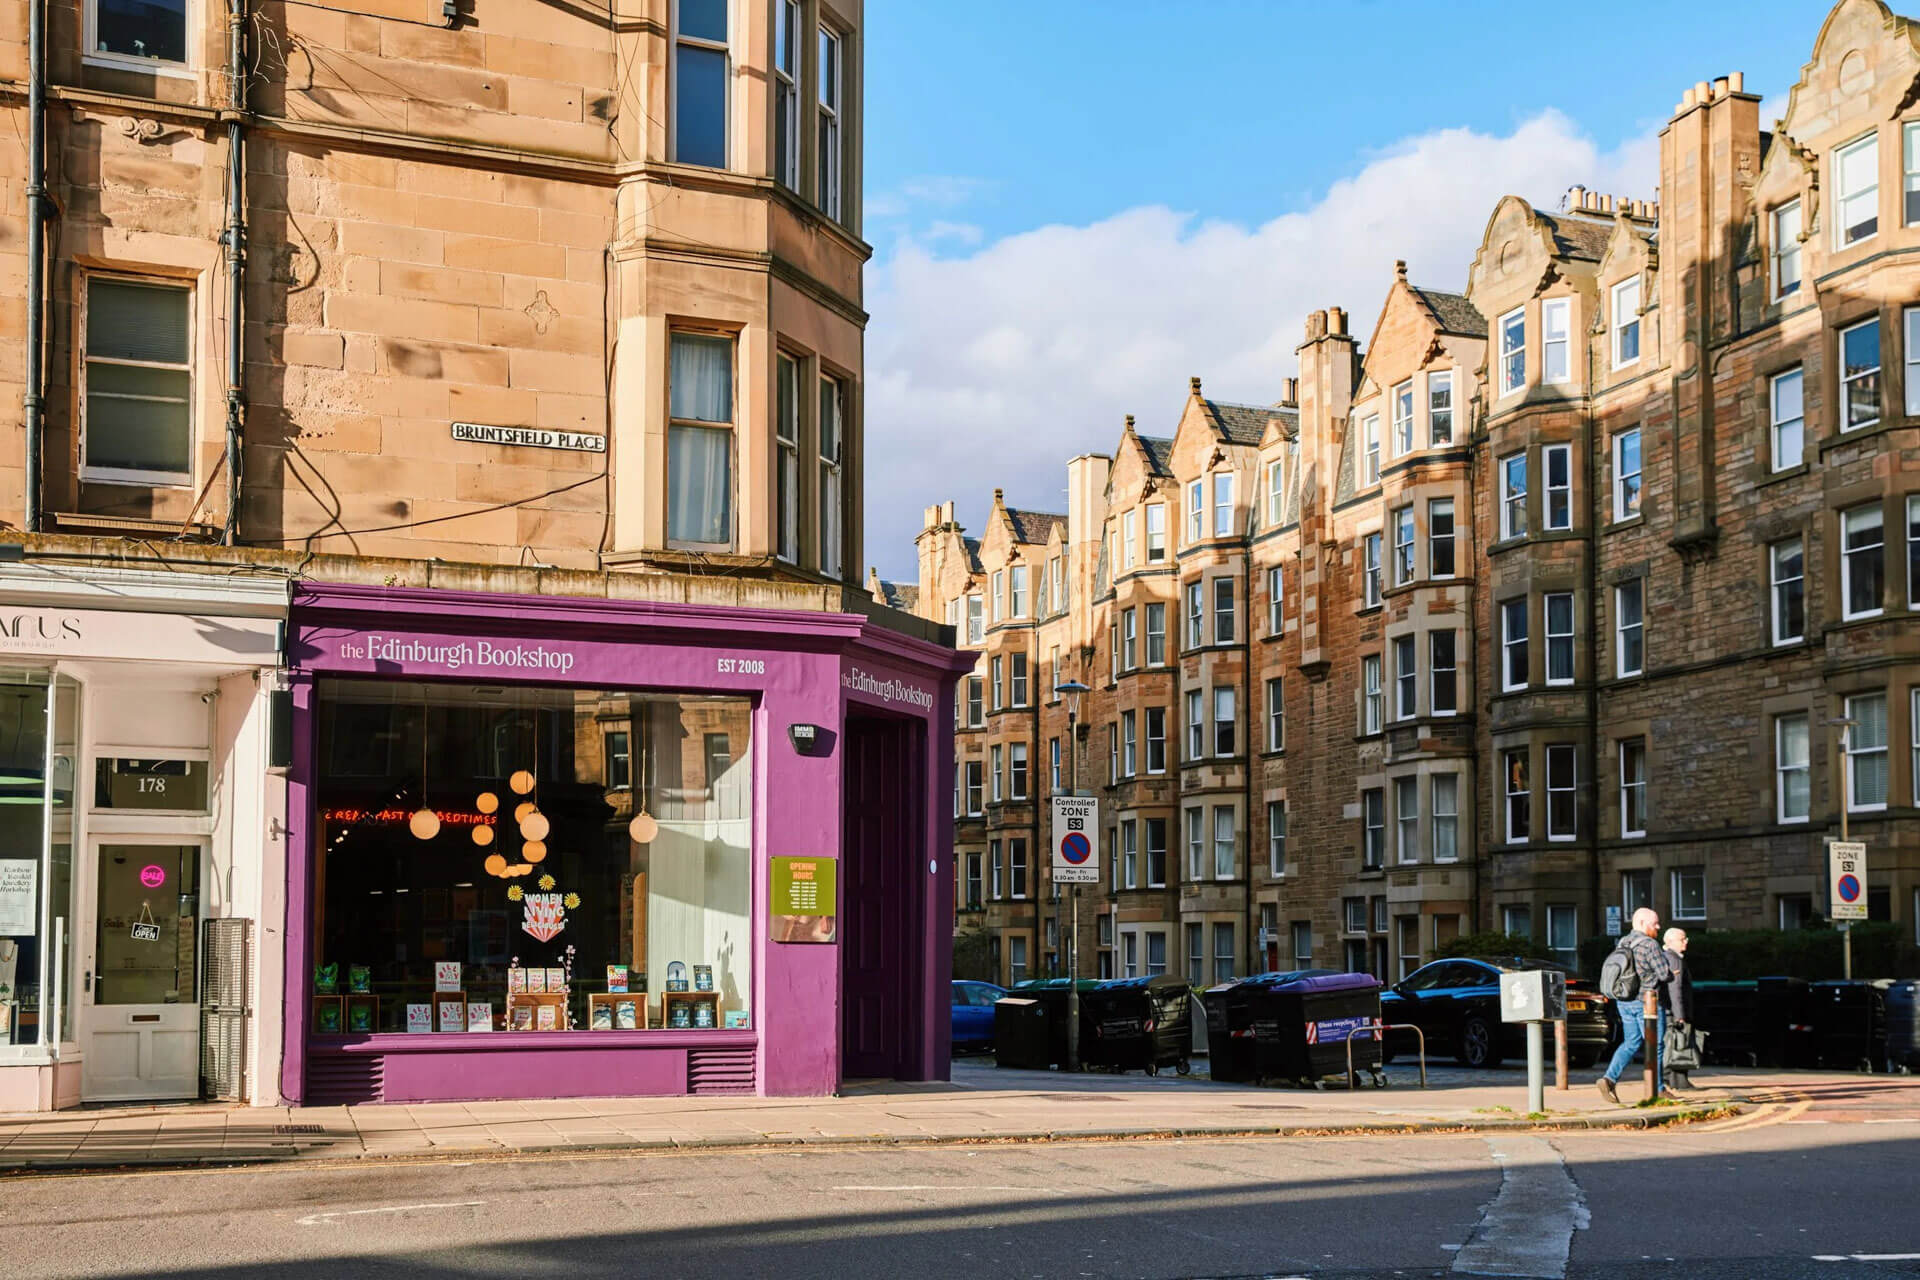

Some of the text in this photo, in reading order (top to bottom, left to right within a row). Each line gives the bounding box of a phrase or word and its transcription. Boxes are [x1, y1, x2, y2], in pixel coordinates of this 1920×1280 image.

[456, 425, 602, 449] BRUNTSFIELD PLACE
[340, 635, 573, 674] the Edinburgh Bookshop
[717, 658, 765, 674] EST 2008
[841, 667, 933, 712] the Edinburgh Bookshop
[138, 778, 166, 792] 178
[1055, 798, 1096, 807] Controlled
[1061, 807, 1089, 816] ZONE
[1069, 820, 1082, 829] S3
[1837, 852, 1859, 860] ZONE
[143, 871, 163, 881] SALE
[792, 871, 814, 880] HOURS
[524, 893, 563, 905] WOMEN
[524, 905, 565, 919] LIVING
[134, 930, 156, 939] OPEN
